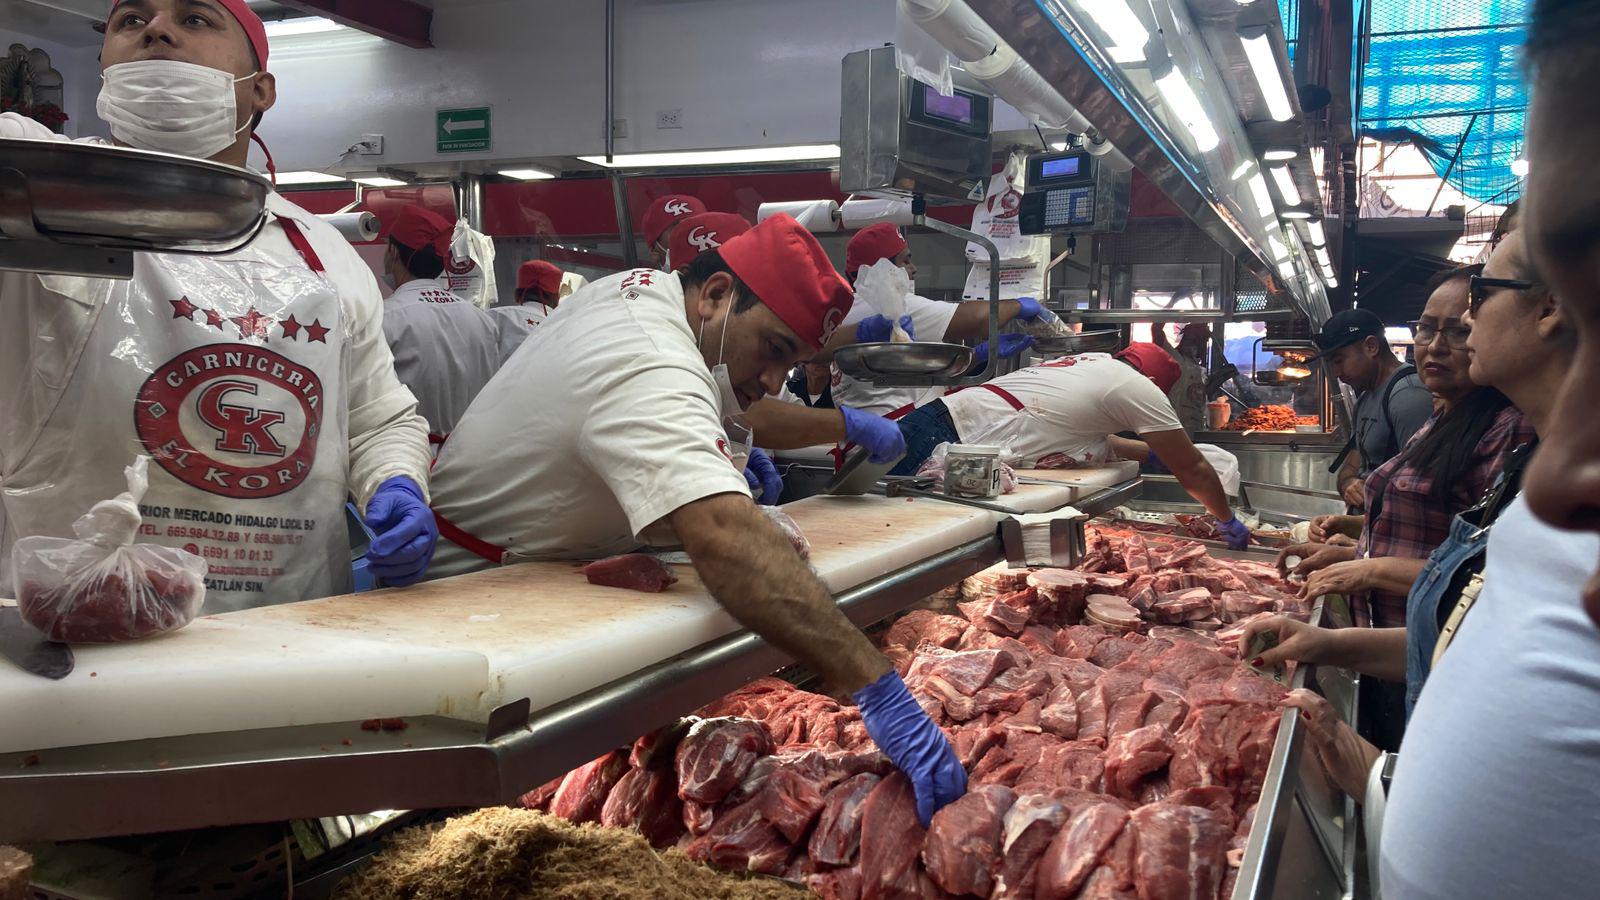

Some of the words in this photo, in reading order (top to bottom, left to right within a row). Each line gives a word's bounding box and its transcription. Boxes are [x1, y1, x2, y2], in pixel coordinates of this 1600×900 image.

[664, 198, 693, 216] CK
[688, 226, 721, 252] CK
[166, 352, 318, 409] CARNICERIA
[196, 380, 286, 457] CK
[160, 440, 190, 468] EL
[203, 460, 308, 489] KORA
[174, 508, 232, 525] MERCADO
[235, 514, 278, 529] HIDALGO
[139, 523, 162, 536] TEL.
[243, 532, 250, 543] Y
[203, 545, 228, 560] 6691
[235, 546, 246, 560] 10
[244, 580, 264, 593] SIN.
